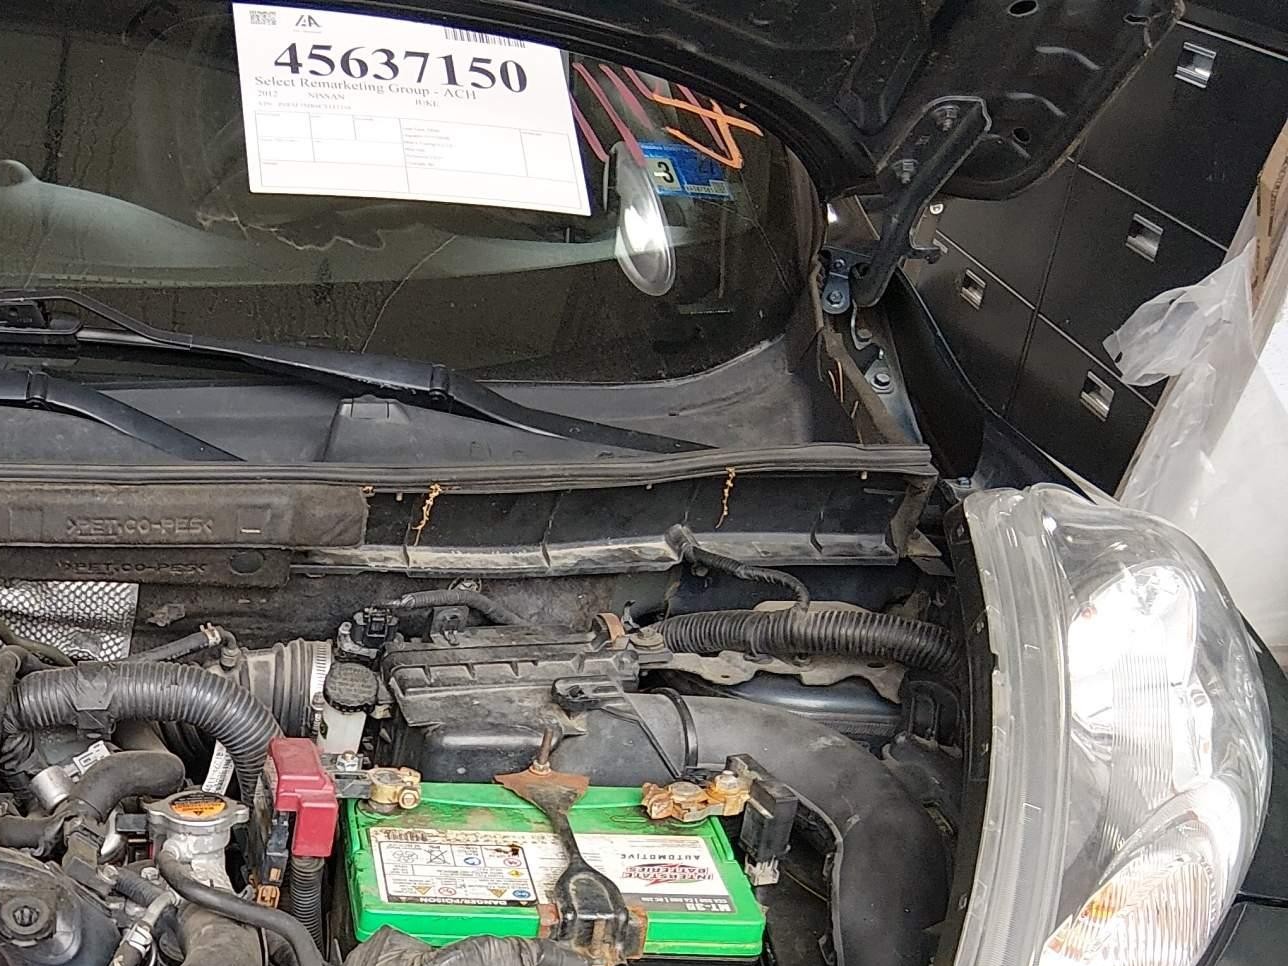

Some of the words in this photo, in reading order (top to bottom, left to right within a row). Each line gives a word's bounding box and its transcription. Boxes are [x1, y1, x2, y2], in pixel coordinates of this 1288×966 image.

[274, 42, 528, 93] 45637150
[255, 76, 295, 88] Select
[299, 77, 385, 94] Remarketing
[388, 82, 430, 97] Group
[307, 92, 346, 101] NISSAN
[657, 161, 674, 183] 3
[621, 872, 712, 880] INTERSTATE
